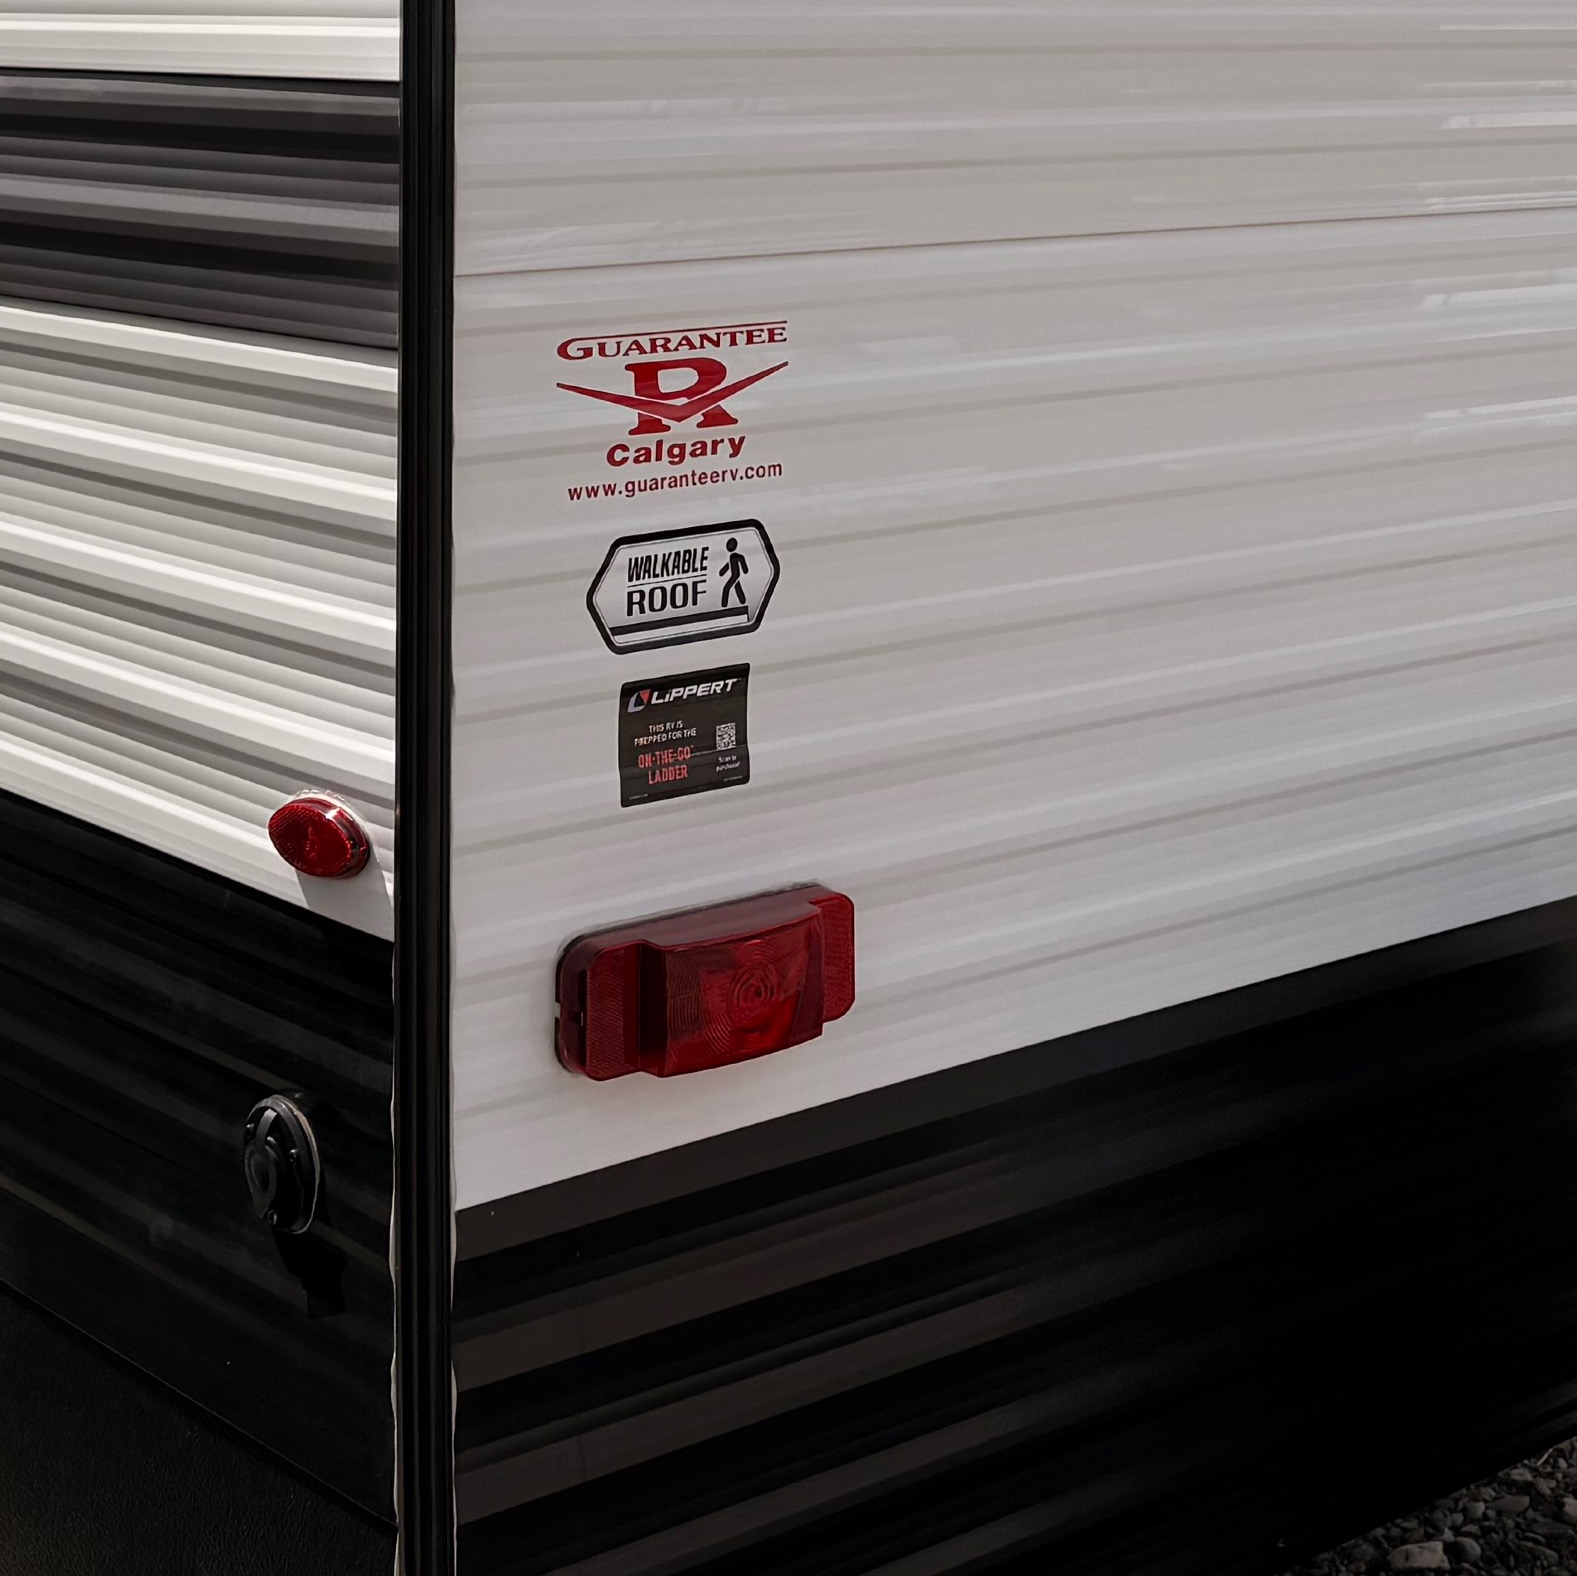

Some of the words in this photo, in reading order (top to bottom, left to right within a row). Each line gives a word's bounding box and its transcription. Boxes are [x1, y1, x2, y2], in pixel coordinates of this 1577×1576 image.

[606, 435, 746, 467] Calgary
[567, 463, 783, 501] www.guaranteerv.com
[627, 546, 710, 583] WALKABLE
[626, 579, 707, 617] ROOF
[648, 723, 665, 734] THIS
[676, 719, 684, 730] IS
[668, 730, 683, 740] FOR
[683, 727, 697, 738] THE
[648, 765, 688, 785] LADDER
